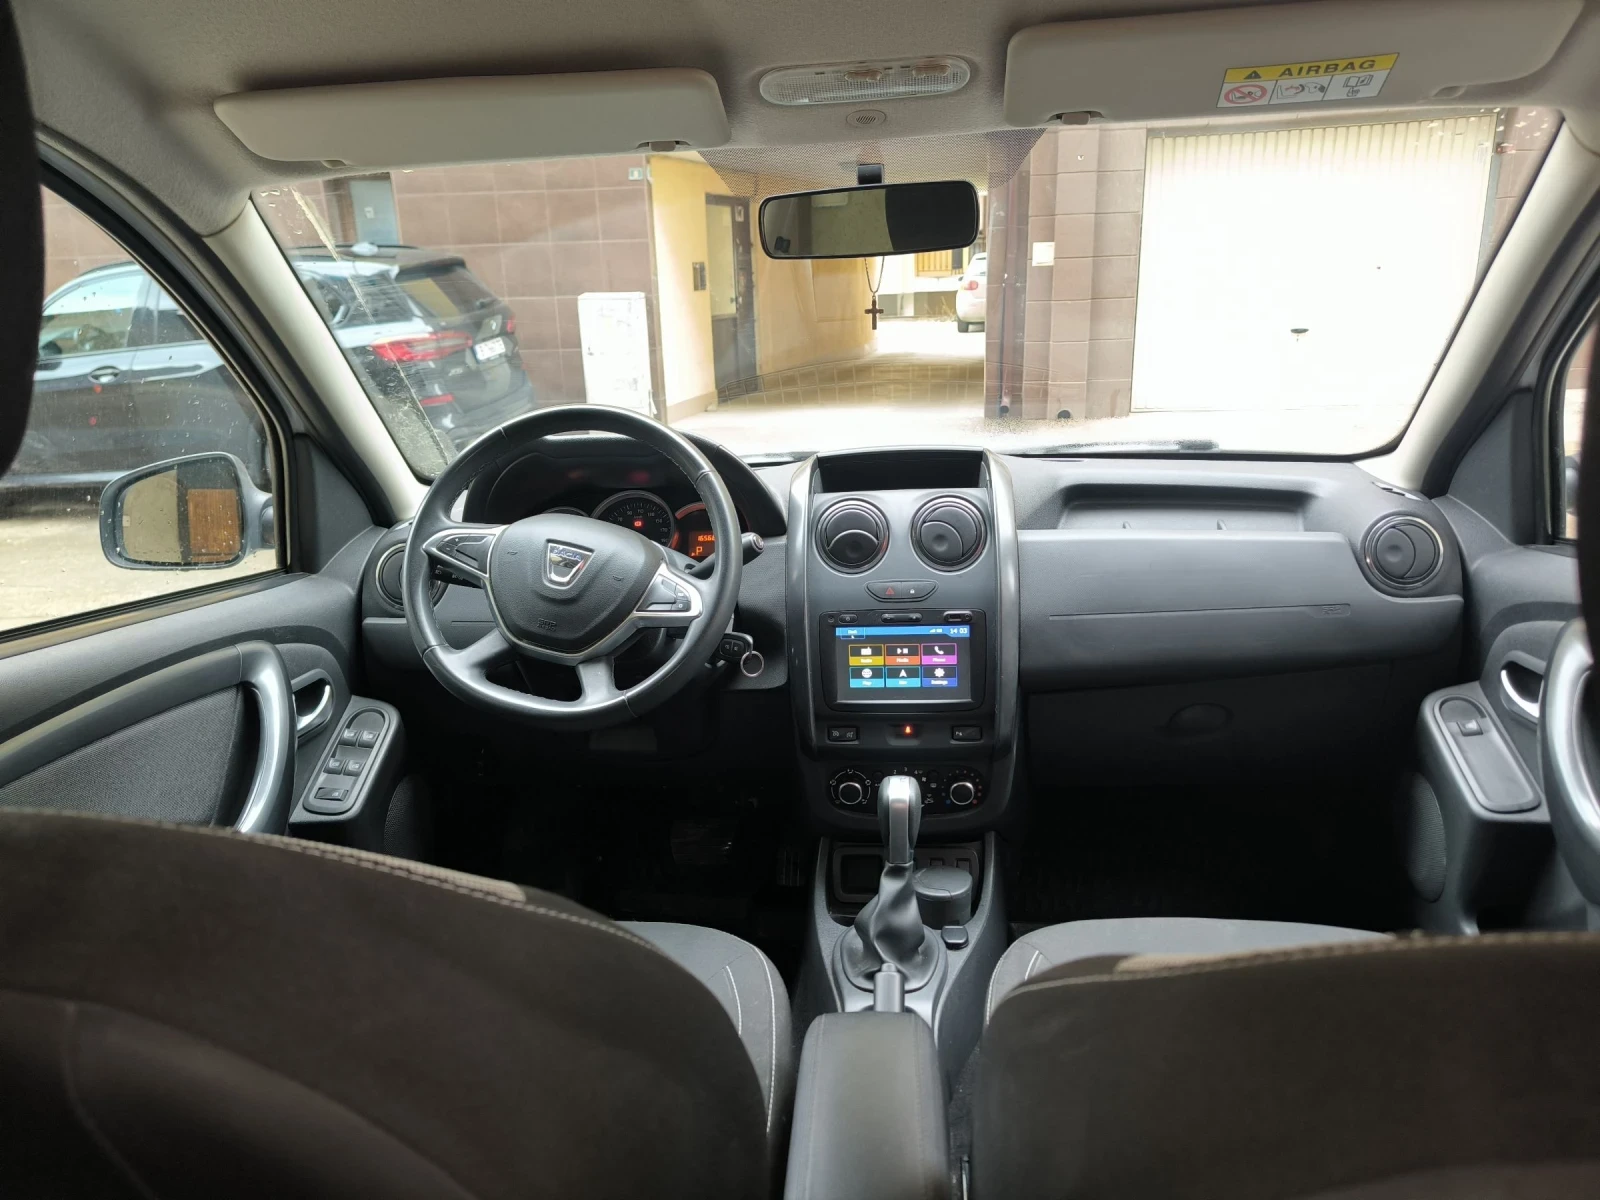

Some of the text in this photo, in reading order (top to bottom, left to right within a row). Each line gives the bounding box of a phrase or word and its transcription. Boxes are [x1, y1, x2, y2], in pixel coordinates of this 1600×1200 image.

[1278, 59, 1376, 78] AIRBAG
[551, 546, 582, 561] DACIA
[696, 546, 703, 556] P
